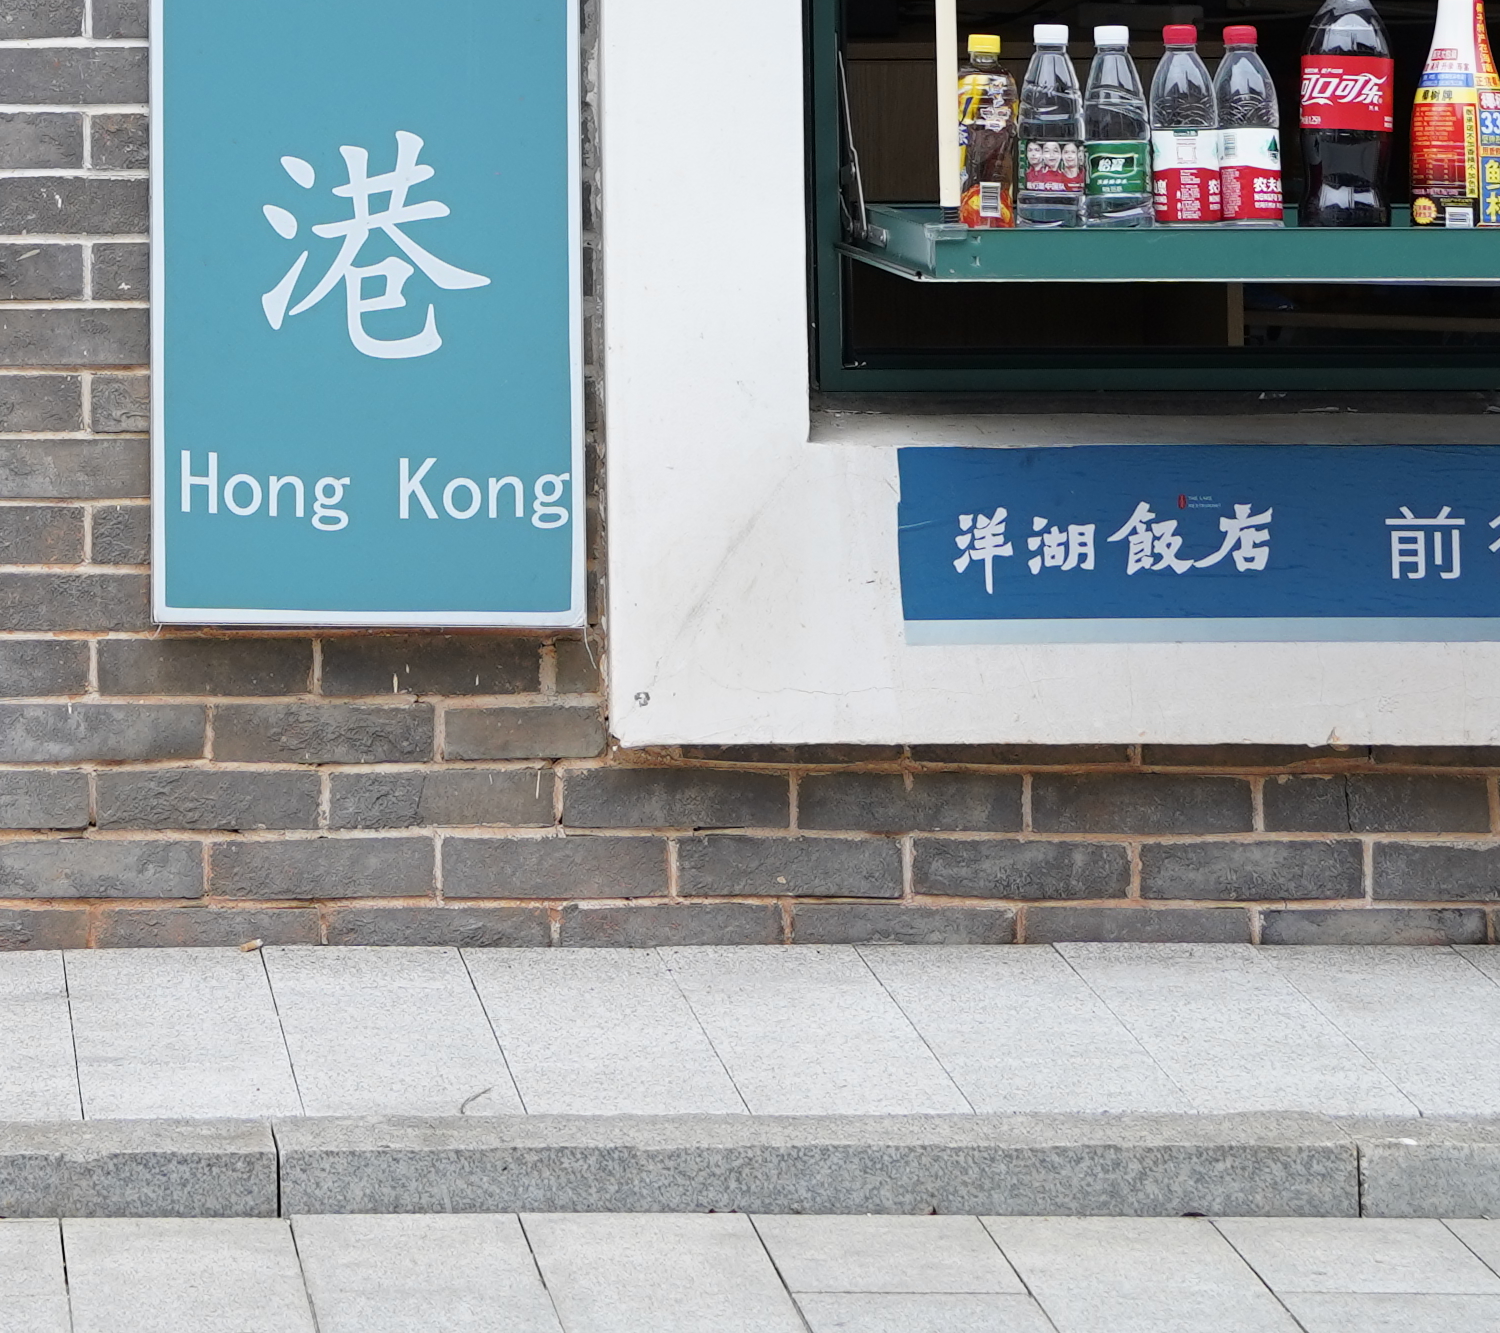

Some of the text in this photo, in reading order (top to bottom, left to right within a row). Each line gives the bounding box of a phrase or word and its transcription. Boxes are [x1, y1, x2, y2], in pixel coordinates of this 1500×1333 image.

[1300, 72, 1388, 106] 可口可乐
[181, 449, 571, 532] Hong Kong
